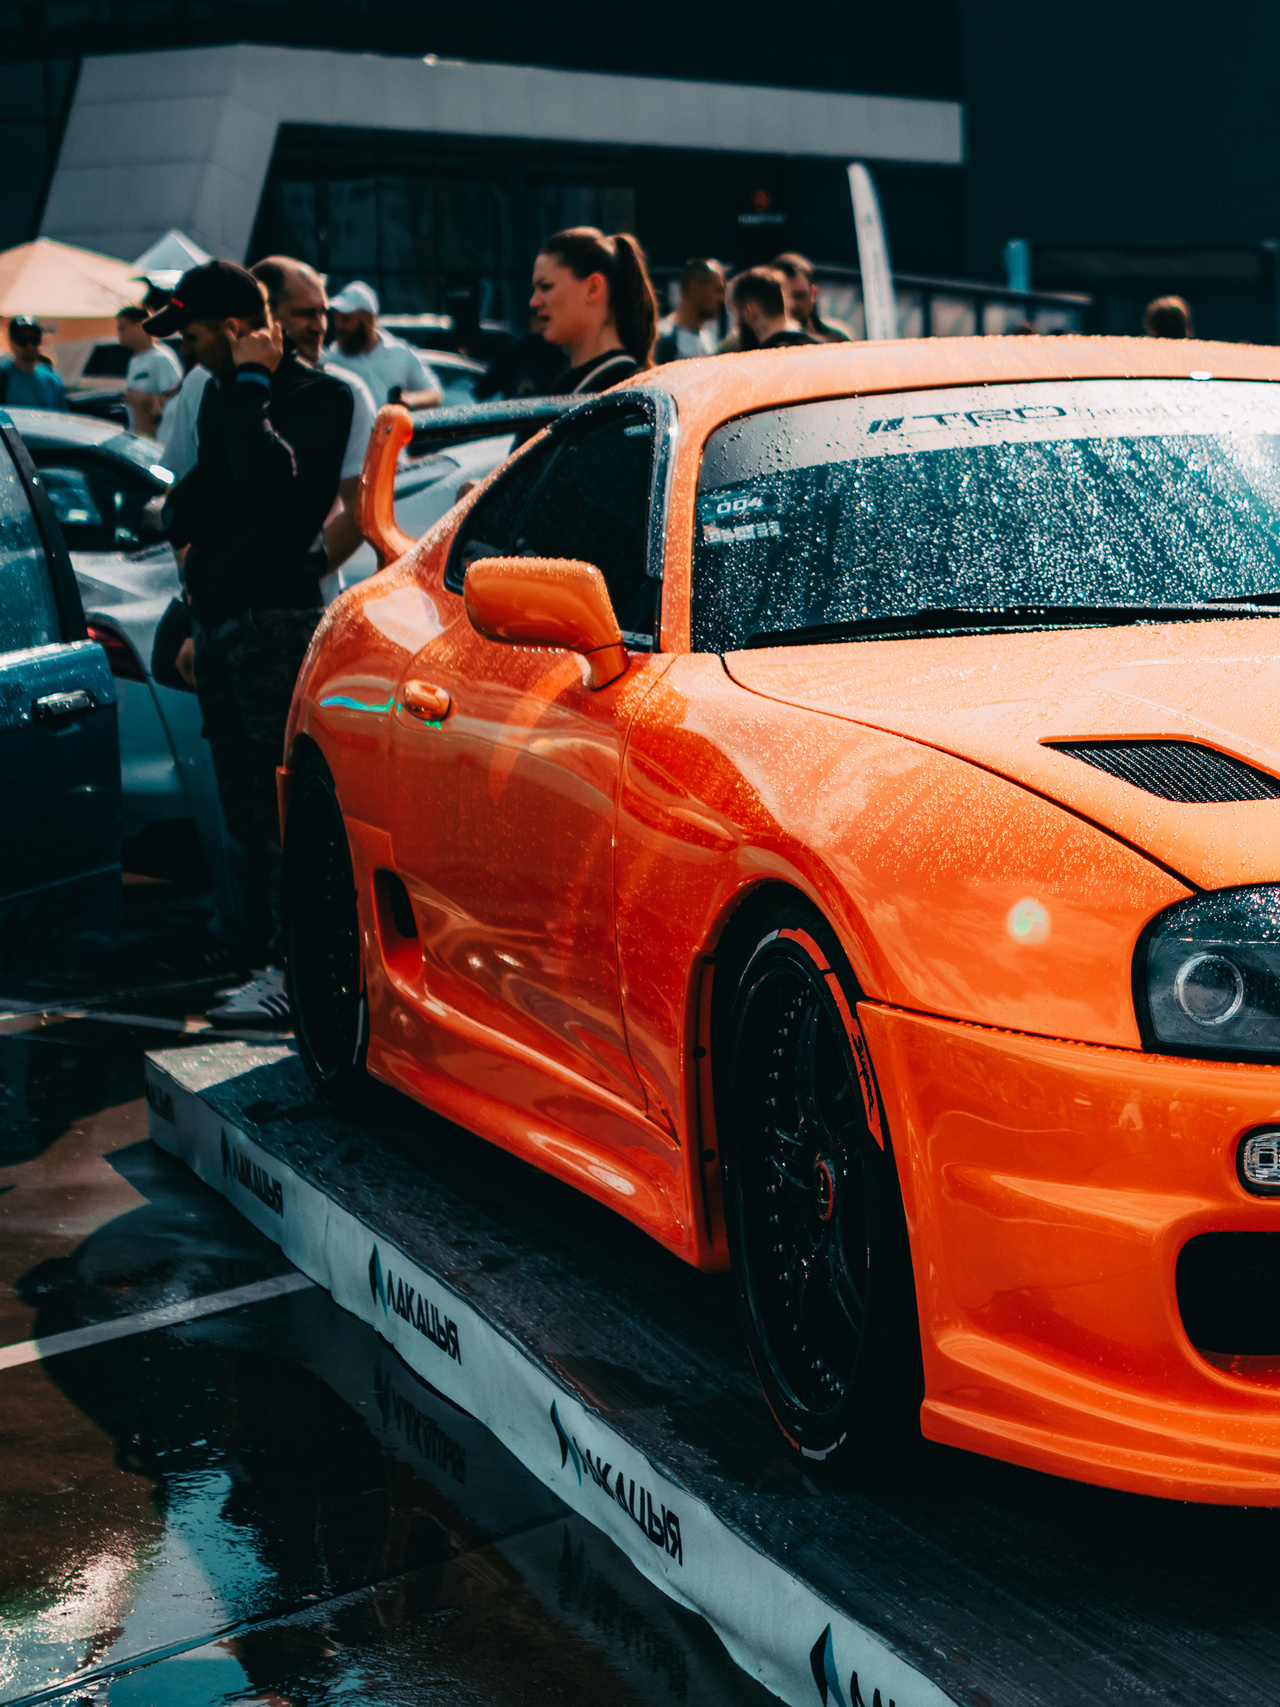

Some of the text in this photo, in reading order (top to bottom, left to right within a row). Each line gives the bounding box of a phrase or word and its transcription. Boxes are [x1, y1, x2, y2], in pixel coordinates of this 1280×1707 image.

[911, 404, 1067, 428] TRD
[851, 1032, 875, 1122] Supra
[387, 1268, 462, 1366] ЛАКАЦЫЯ
